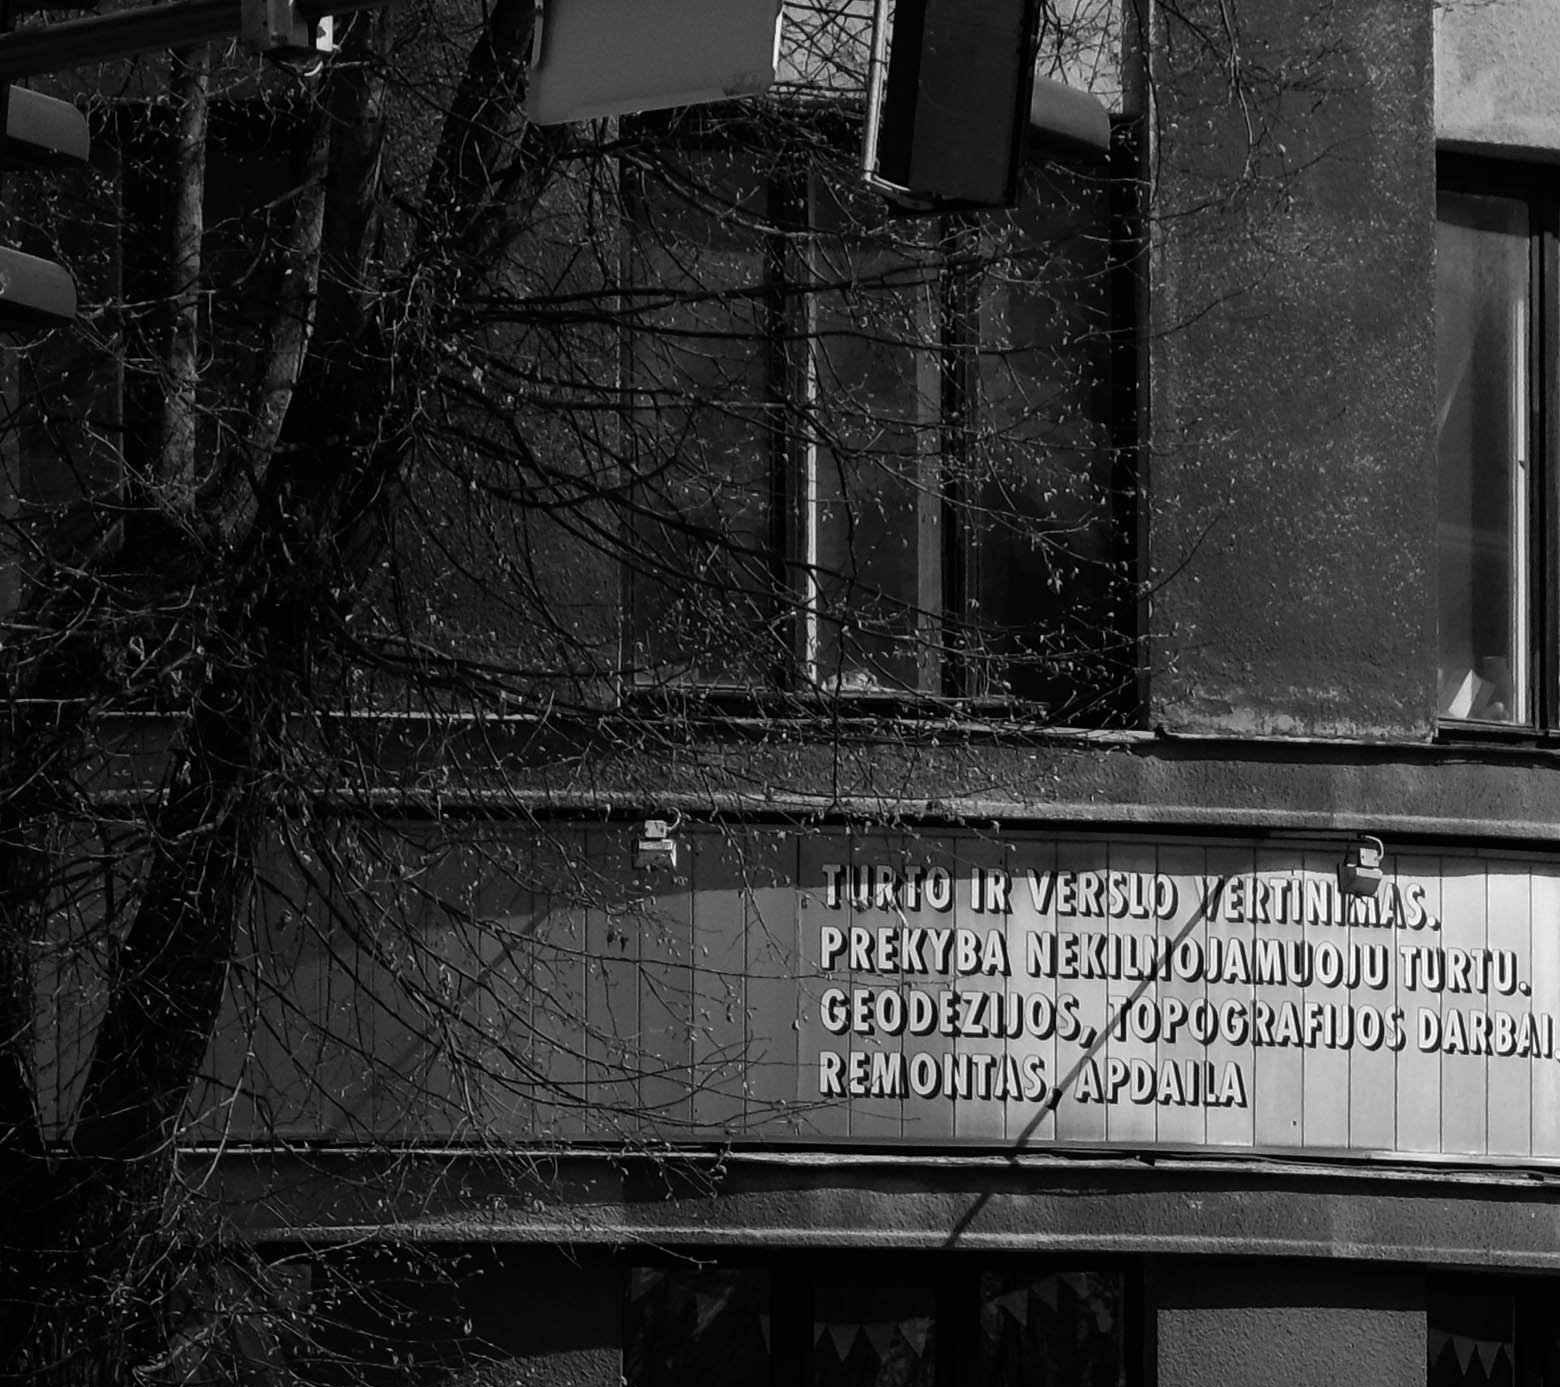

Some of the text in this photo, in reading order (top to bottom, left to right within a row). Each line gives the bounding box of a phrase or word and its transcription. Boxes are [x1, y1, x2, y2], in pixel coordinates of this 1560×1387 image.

[821, 864, 953, 912] TURTO
[970, 866, 1012, 915] IR
[1025, 867, 1179, 920] VERSLO
[820, 926, 1532, 997] PREKYBA NEKILNOJAMUOJU TURTU.
[1107, 992, 1407, 1052] TOPOGRAFIJOS
[1073, 1055, 1248, 1108] APDAILA
